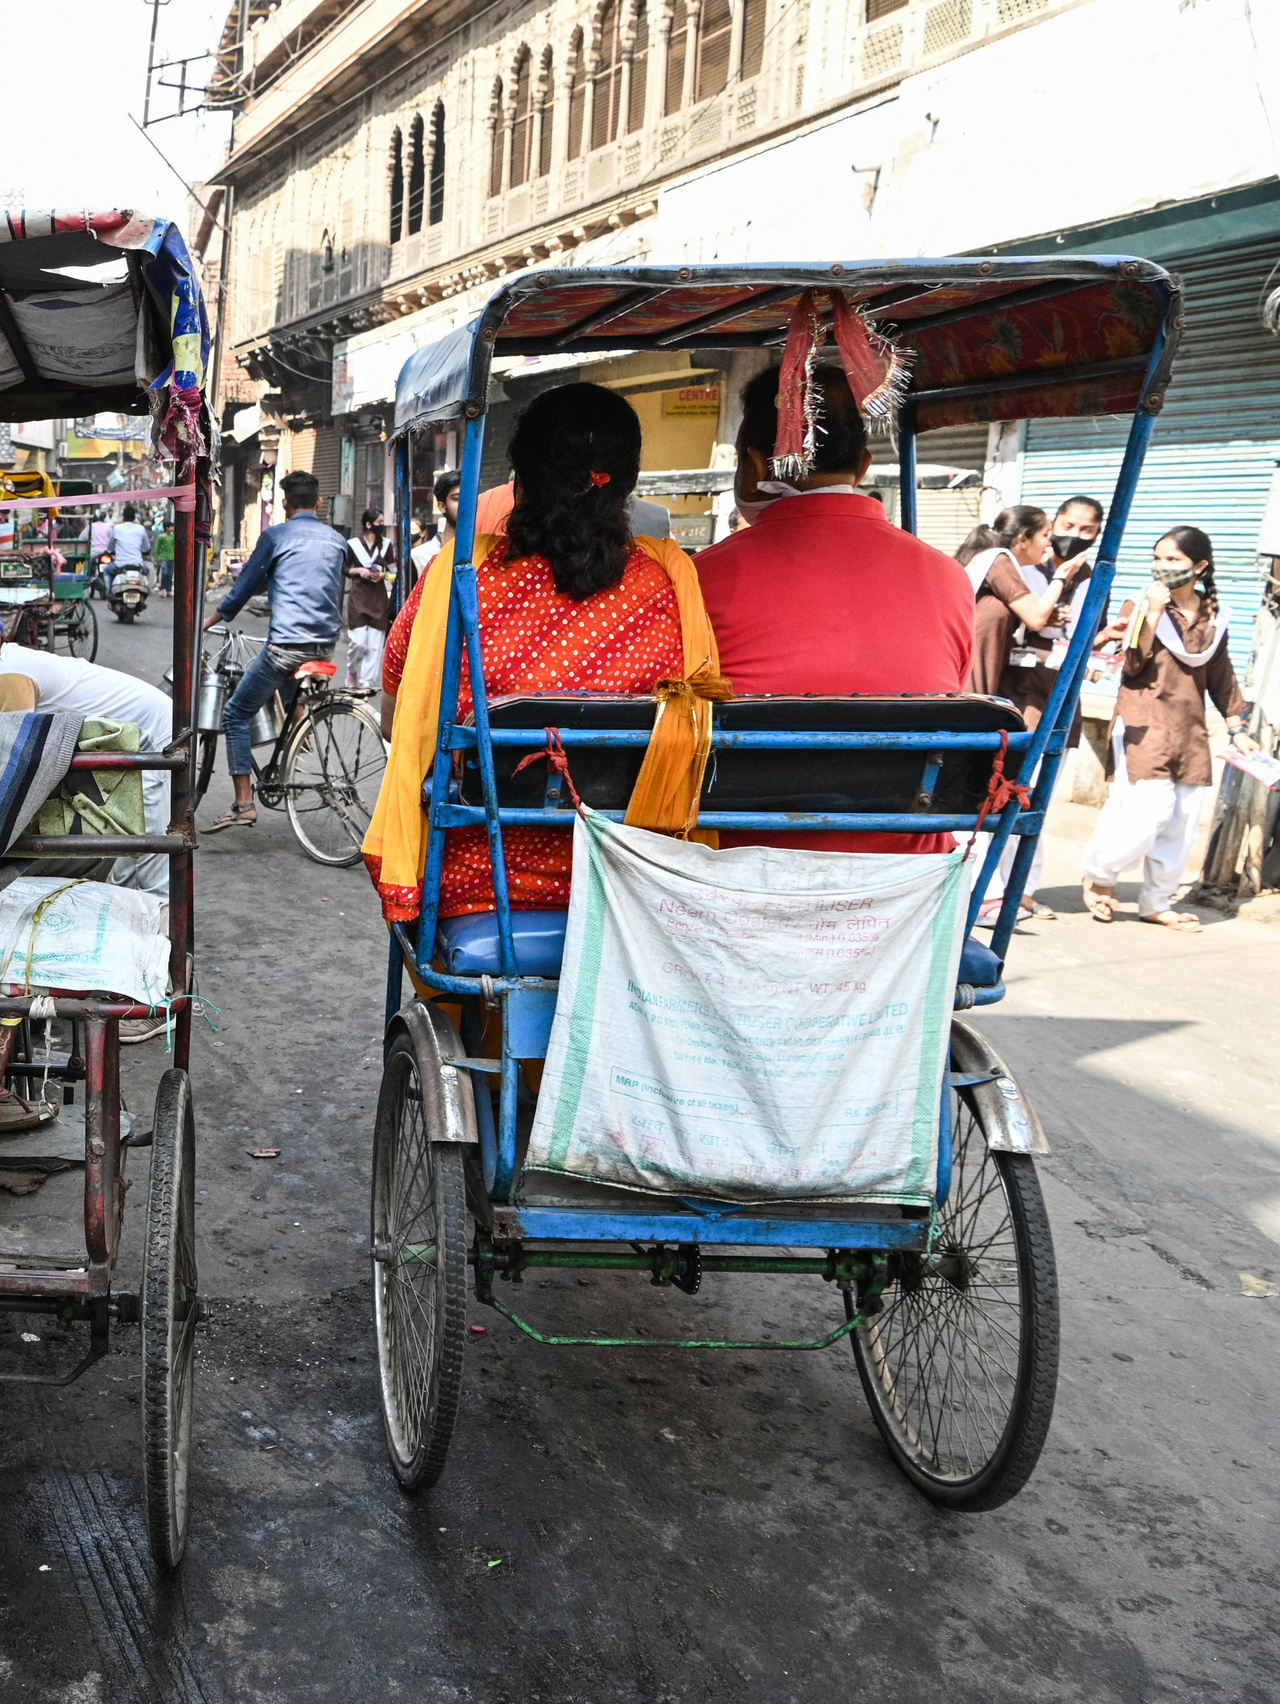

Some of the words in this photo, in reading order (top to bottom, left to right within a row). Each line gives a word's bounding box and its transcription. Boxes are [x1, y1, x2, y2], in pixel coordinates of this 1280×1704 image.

[679, 389, 717, 401] CENTRE
[659, 898, 717, 922] Neem
[615, 1074, 639, 1088] MRP
[708, 1101, 739, 1112] taxes)
